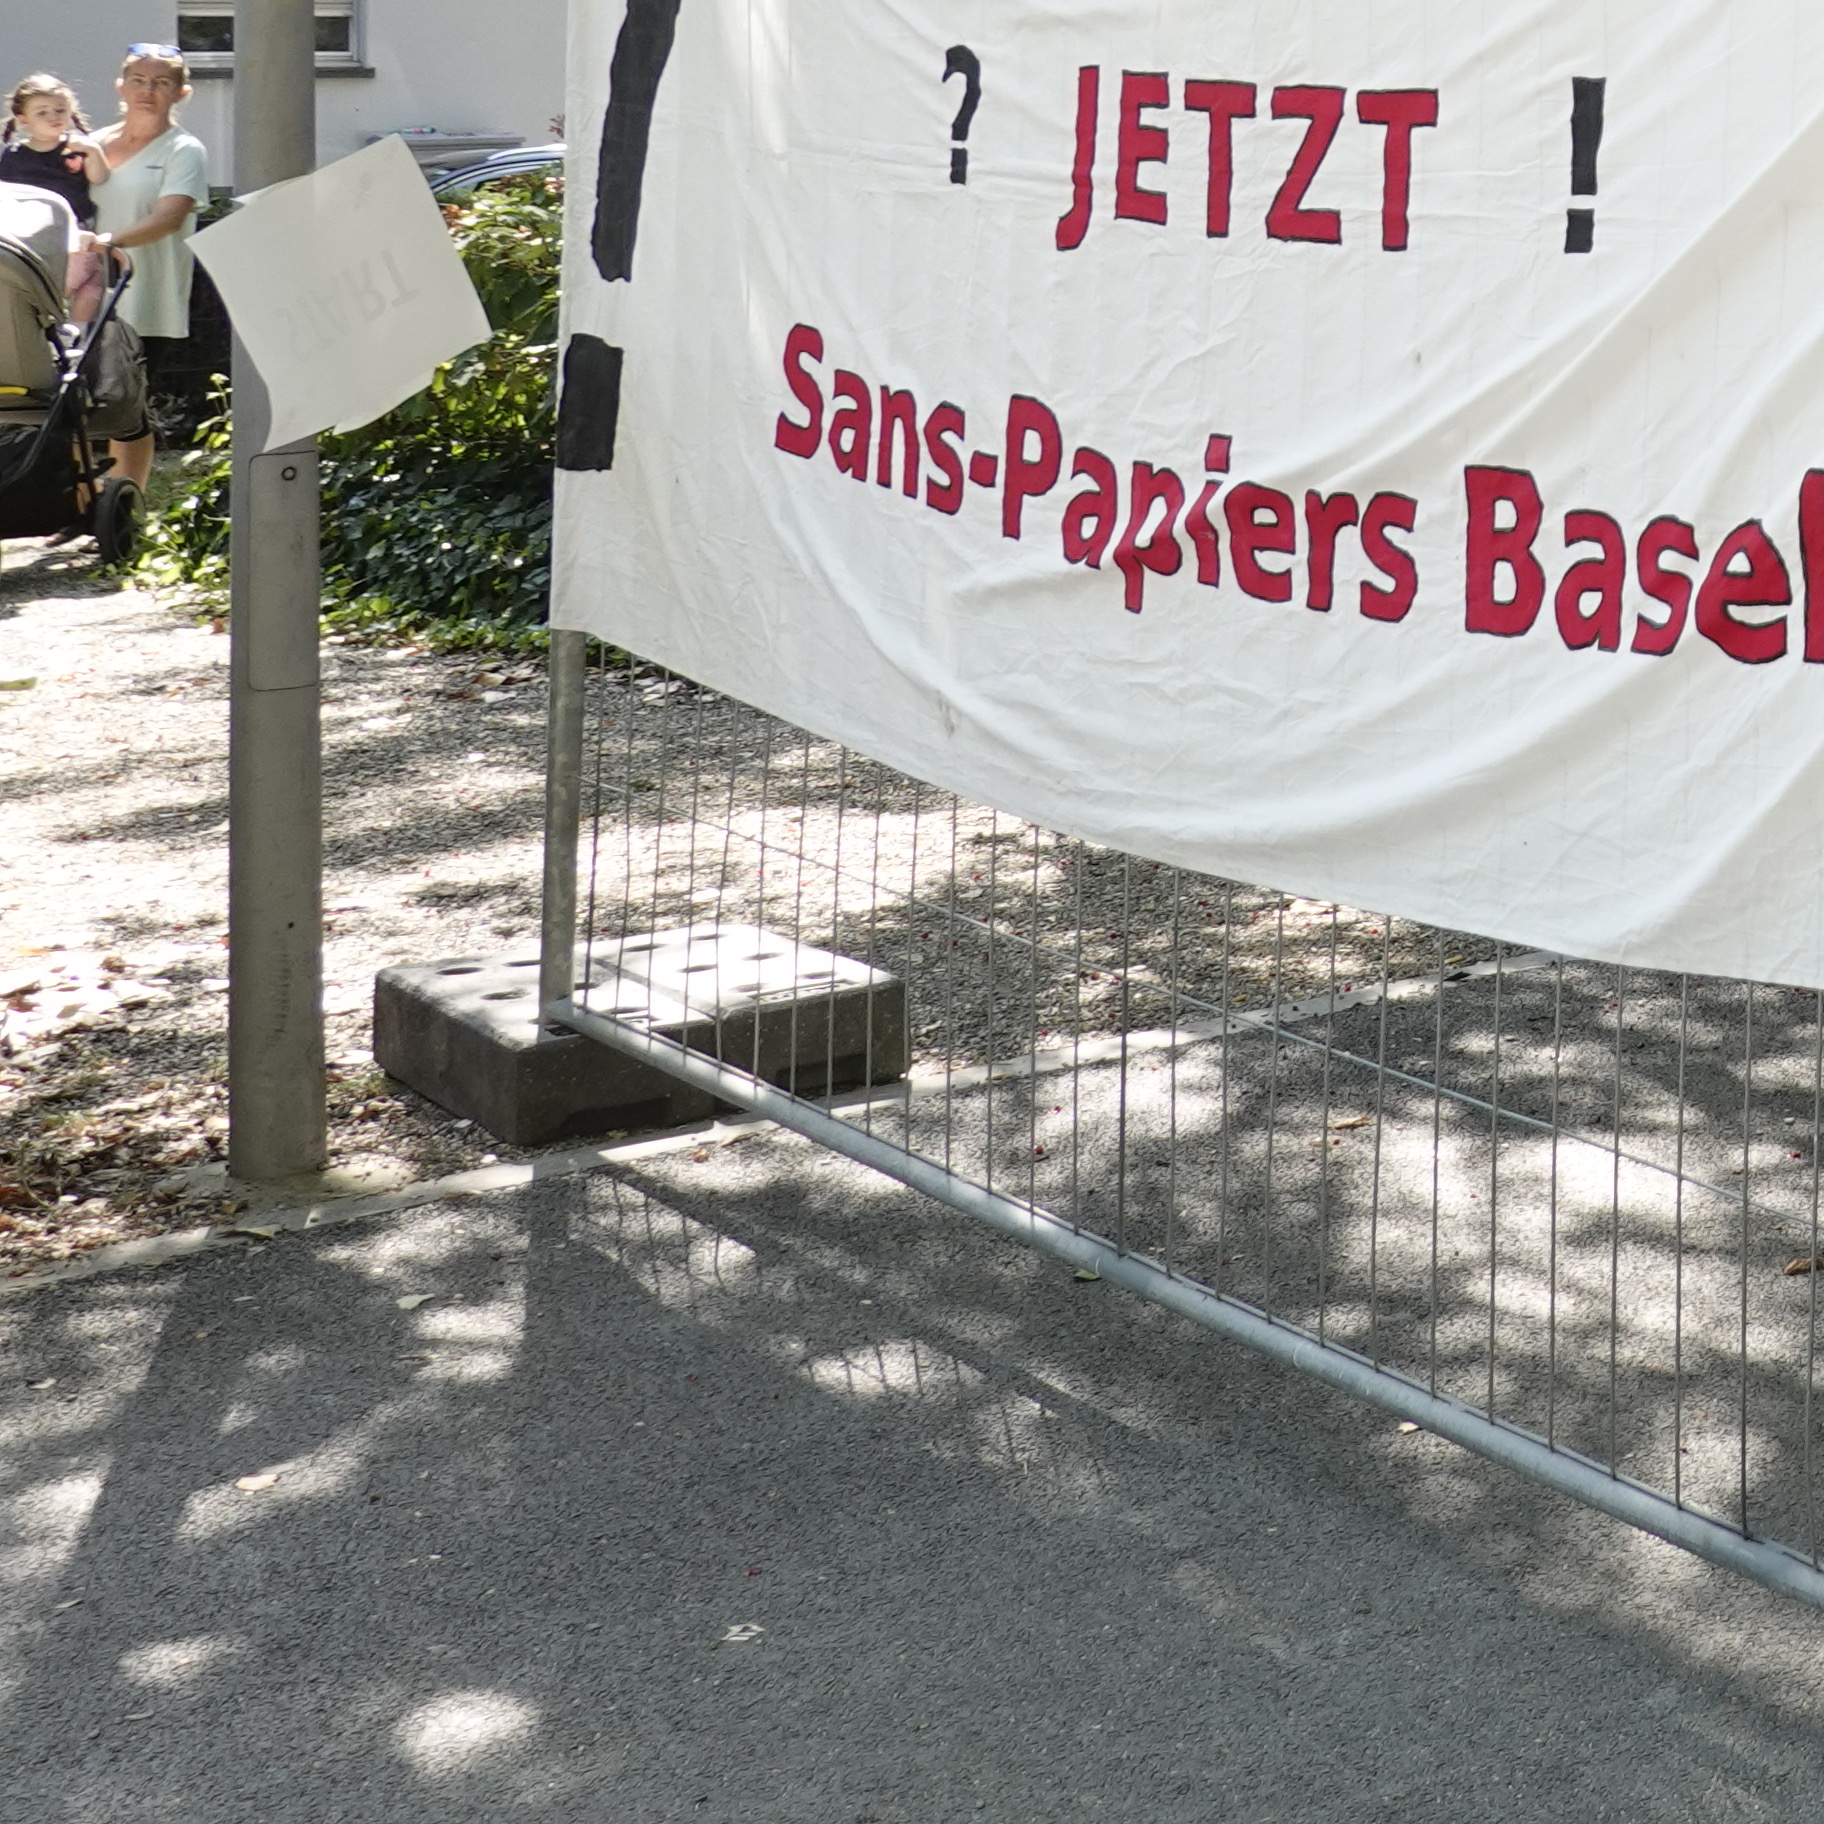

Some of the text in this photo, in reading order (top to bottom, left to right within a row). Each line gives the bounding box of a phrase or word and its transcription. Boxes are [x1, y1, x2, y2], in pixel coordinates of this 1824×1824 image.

[942, 45, 1605, 254] ? JETZT !
[775, 323, 1418, 624] Sans-Papiers
